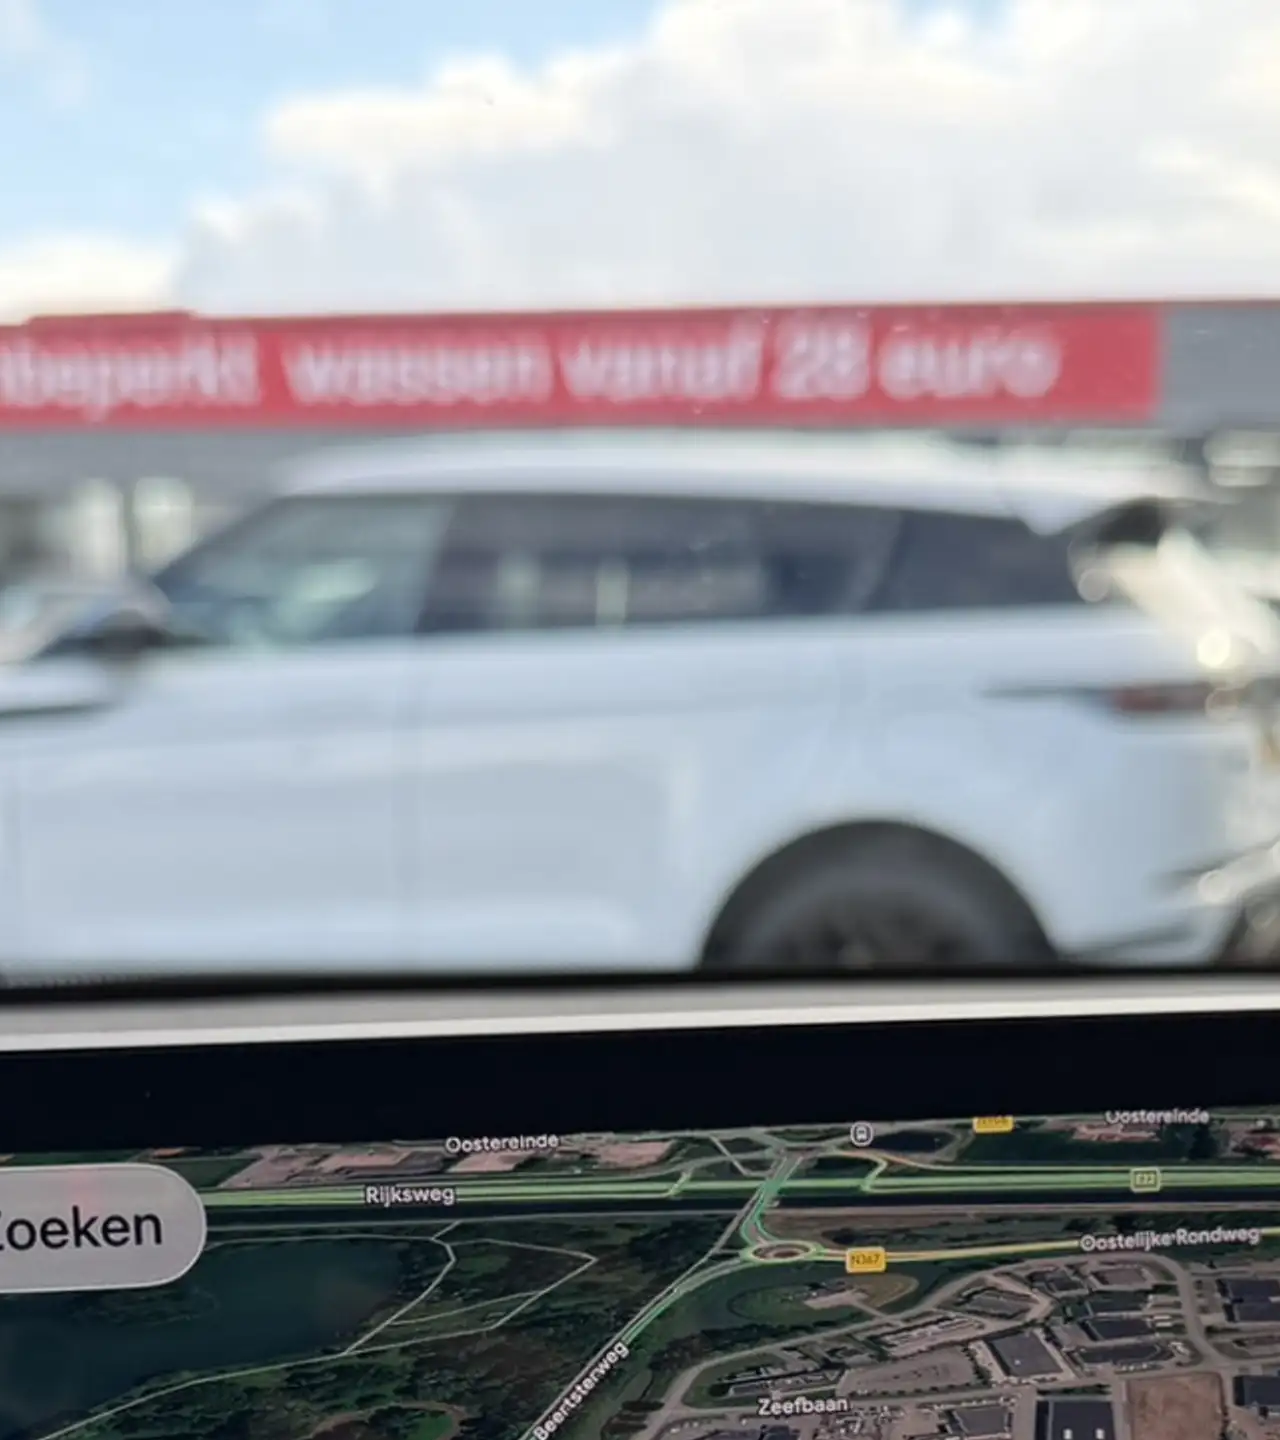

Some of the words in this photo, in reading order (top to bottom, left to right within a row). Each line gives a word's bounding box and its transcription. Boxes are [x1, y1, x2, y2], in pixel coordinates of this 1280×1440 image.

[282, 333, 553, 405] wassen
[561, 313, 764, 402] vanaf
[770, 313, 873, 402] 28
[445, 1132, 560, 1154] Oostereinde
[365, 1184, 456, 1209] Rijksweg
[1079, 1232, 1172, 1252] Oostelijke
[1175, 1226, 1261, 1245] Rondweg
[757, 1395, 849, 1416] Zeefbaan
